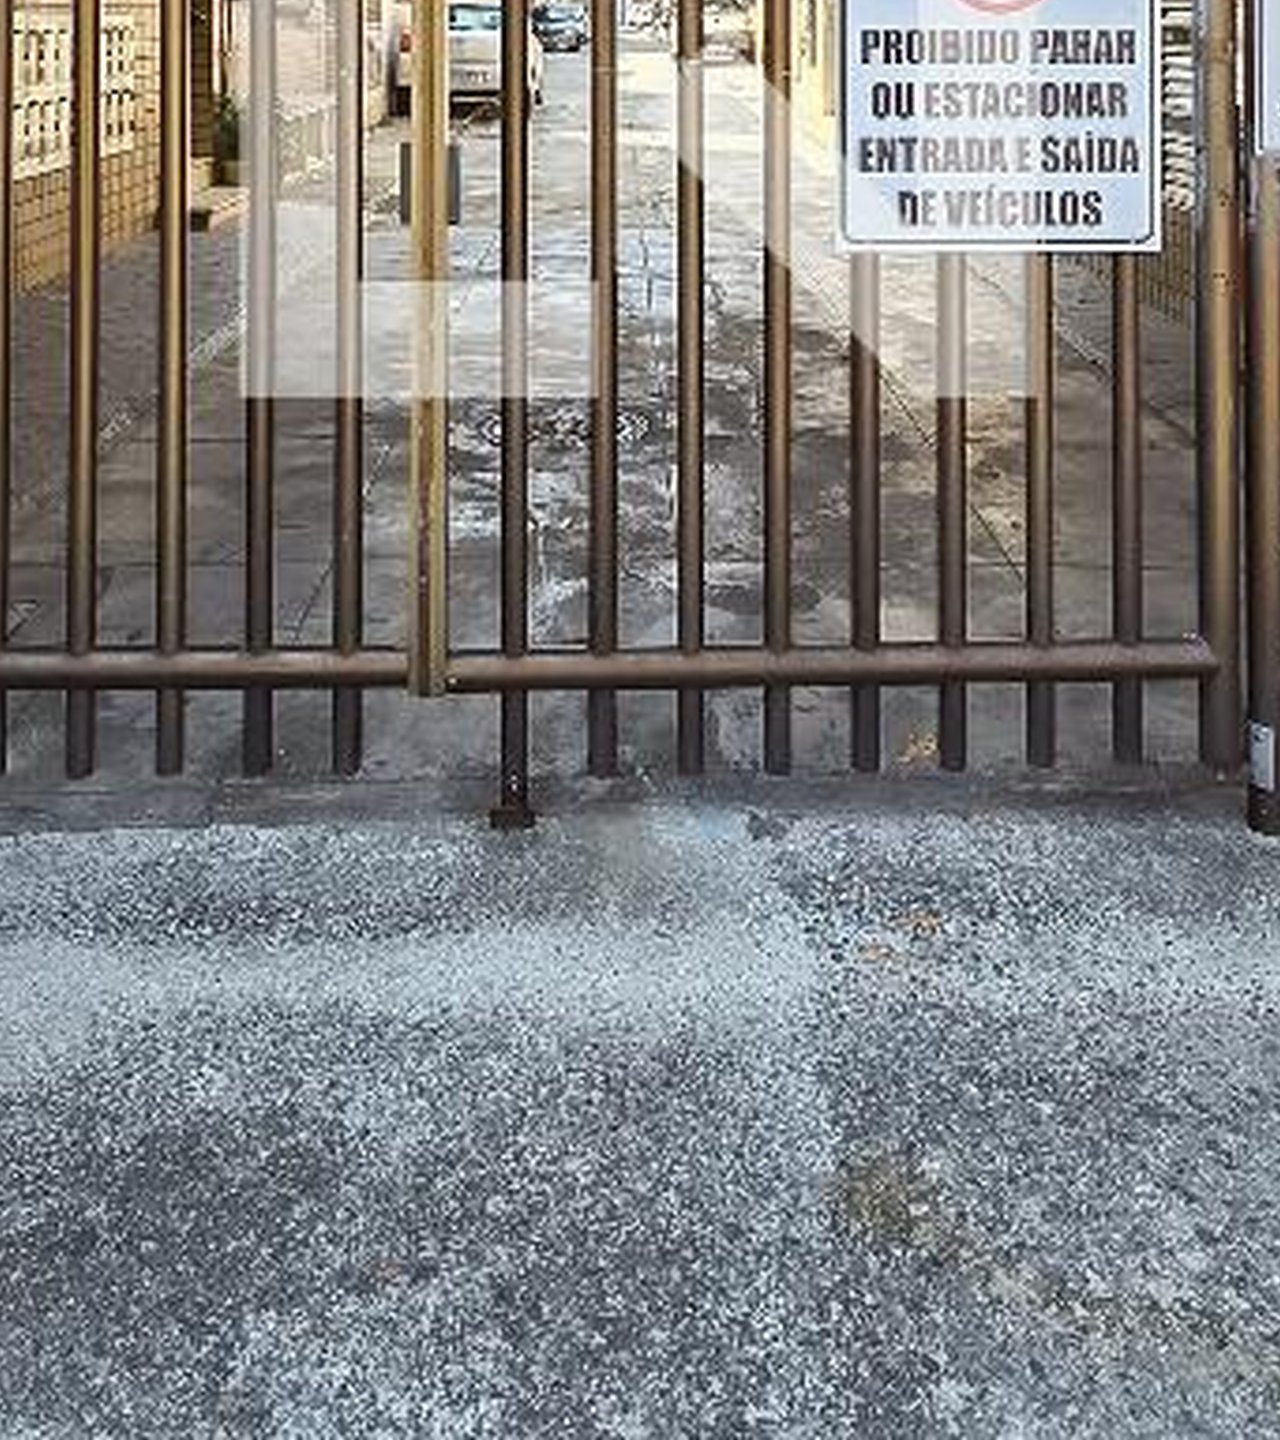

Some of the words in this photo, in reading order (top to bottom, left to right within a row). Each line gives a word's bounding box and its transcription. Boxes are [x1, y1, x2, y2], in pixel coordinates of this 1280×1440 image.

[861, 29, 1018, 64] PROIBIDO
[1031, 30, 1135, 64] PARAR
[871, 82, 914, 118] OU
[924, 82, 1127, 119] ESTACIONAR
[860, 137, 1008, 173] ENTRADA
[1014, 138, 1031, 173] E
[1041, 131, 1139, 174] SAÍDA
[898, 191, 934, 225] DE
[944, 184, 1102, 226] VEÍCULOS
